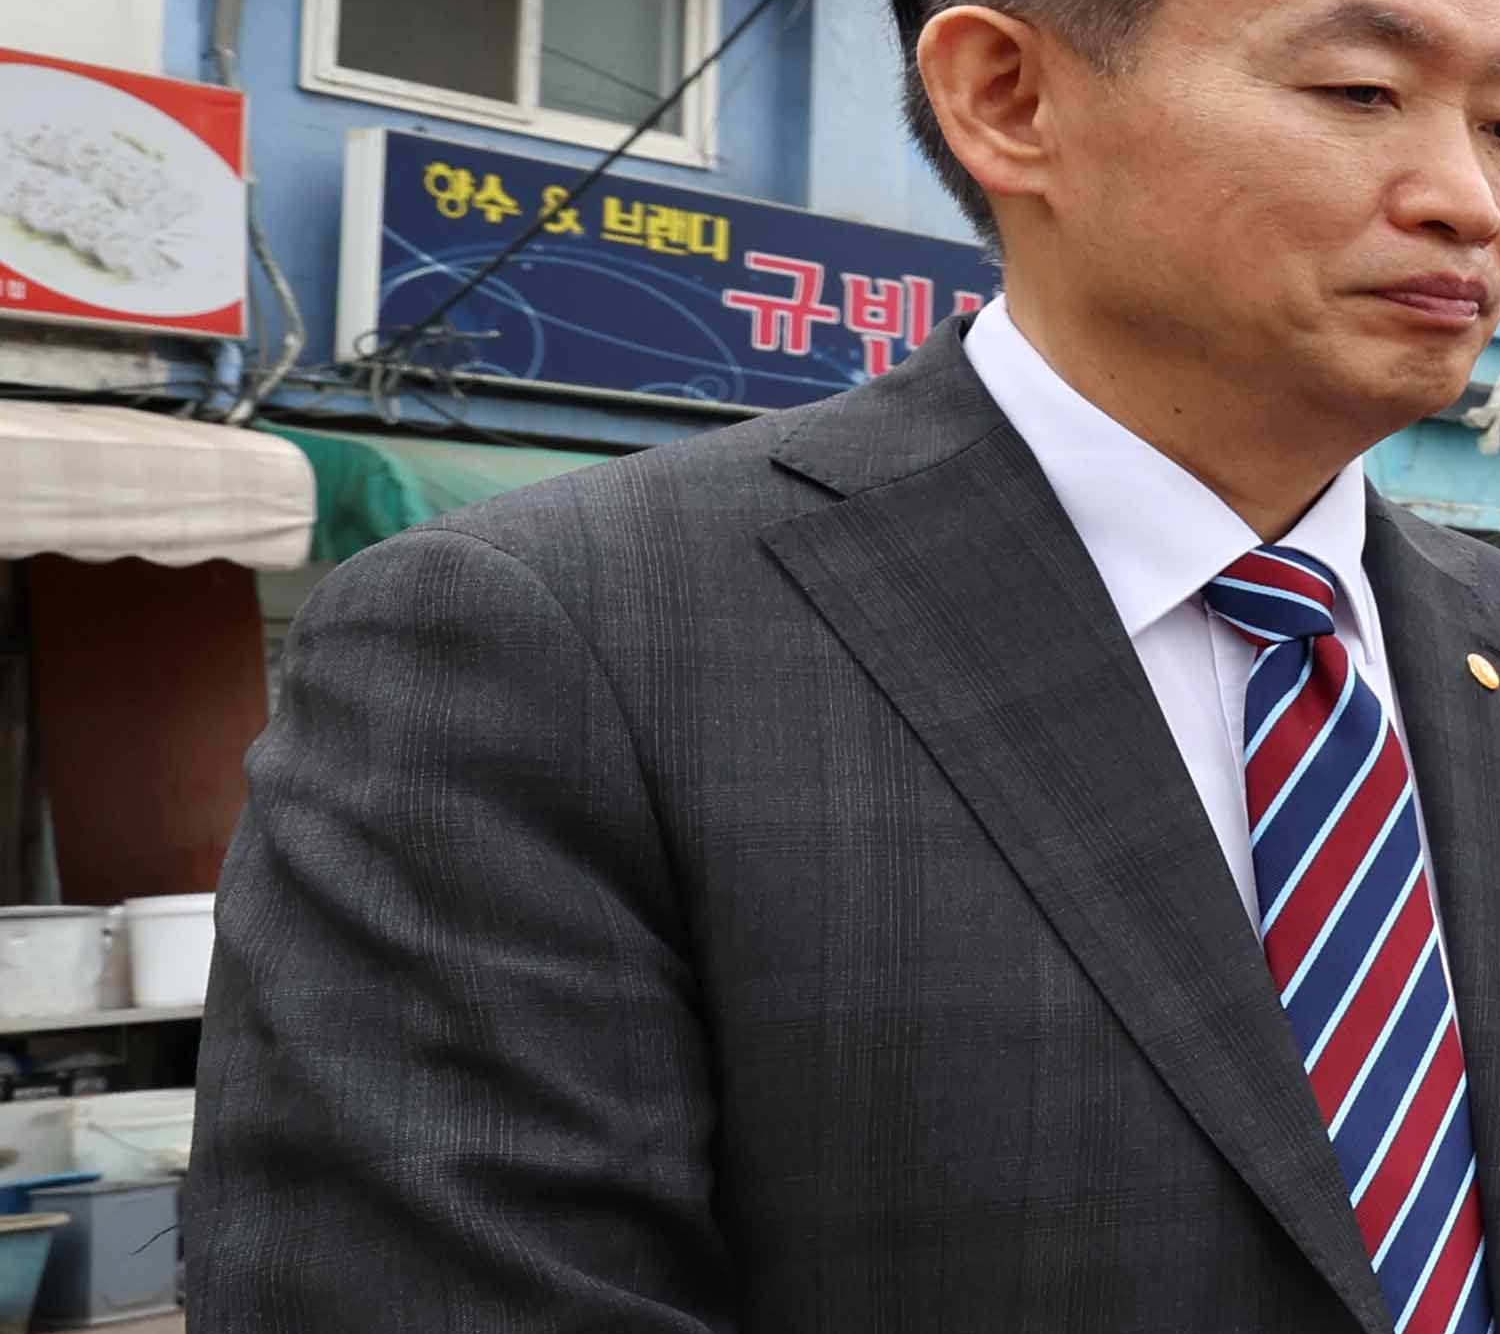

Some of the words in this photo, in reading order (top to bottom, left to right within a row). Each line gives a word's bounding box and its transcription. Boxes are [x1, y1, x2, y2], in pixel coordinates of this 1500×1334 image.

[424, 162, 520, 222] 향수
[542, 186, 584, 235] &
[722, 250, 985, 376] 규빈
